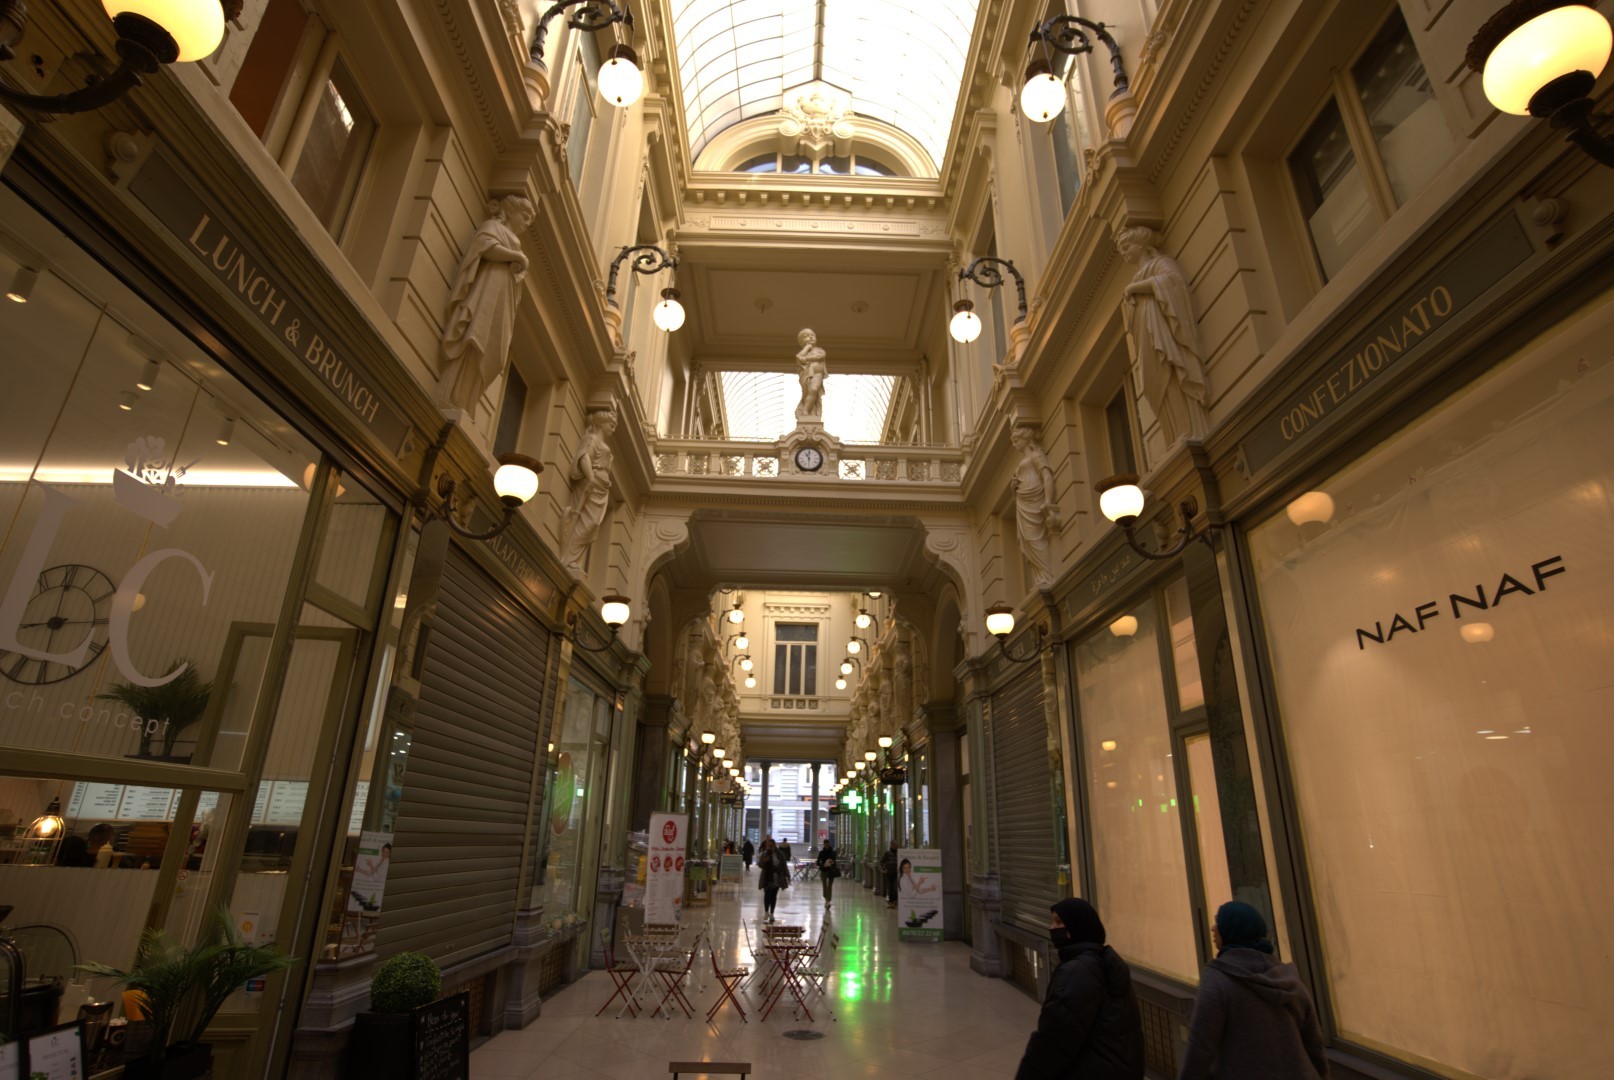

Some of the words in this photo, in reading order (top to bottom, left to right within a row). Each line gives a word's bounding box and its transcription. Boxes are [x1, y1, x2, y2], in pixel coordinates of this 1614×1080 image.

[188, 214, 287, 326] LUNCH
[285, 318, 301, 348] &
[304, 334, 380, 424] BRUNCH
[1280, 285, 1453, 441] CONFEZIONATO
[1356, 601, 1439, 650] NAF
[1449, 555, 1566, 619] NAF
[59, 702, 170, 736] concept
